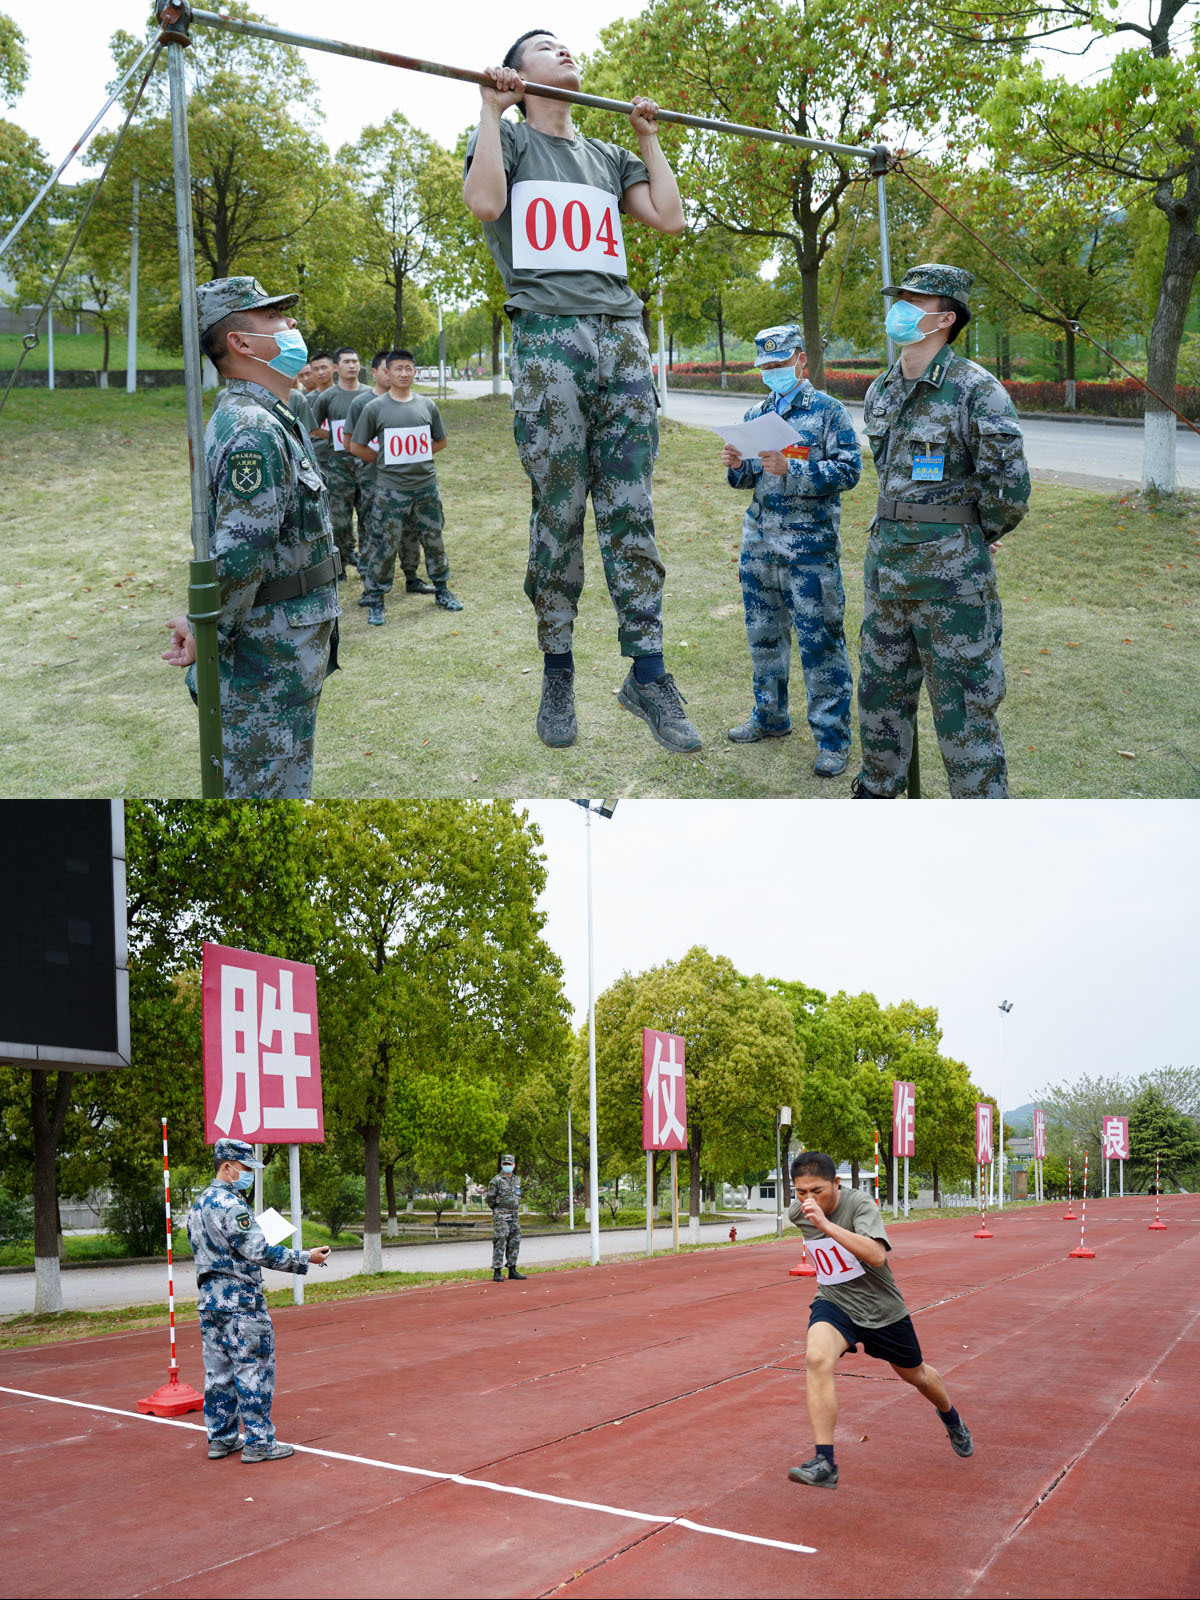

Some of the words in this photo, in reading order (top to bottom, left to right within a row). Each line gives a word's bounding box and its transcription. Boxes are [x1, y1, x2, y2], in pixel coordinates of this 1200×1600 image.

[525, 197, 619, 257] 004
[389, 432, 429, 457] 008
[214, 964, 319, 1136] 胜
[646, 1036, 685, 1146] 仗
[896, 1084, 914, 1155] 作
[978, 1106, 992, 1161] 风
[1106, 1118, 1127, 1158] 良
